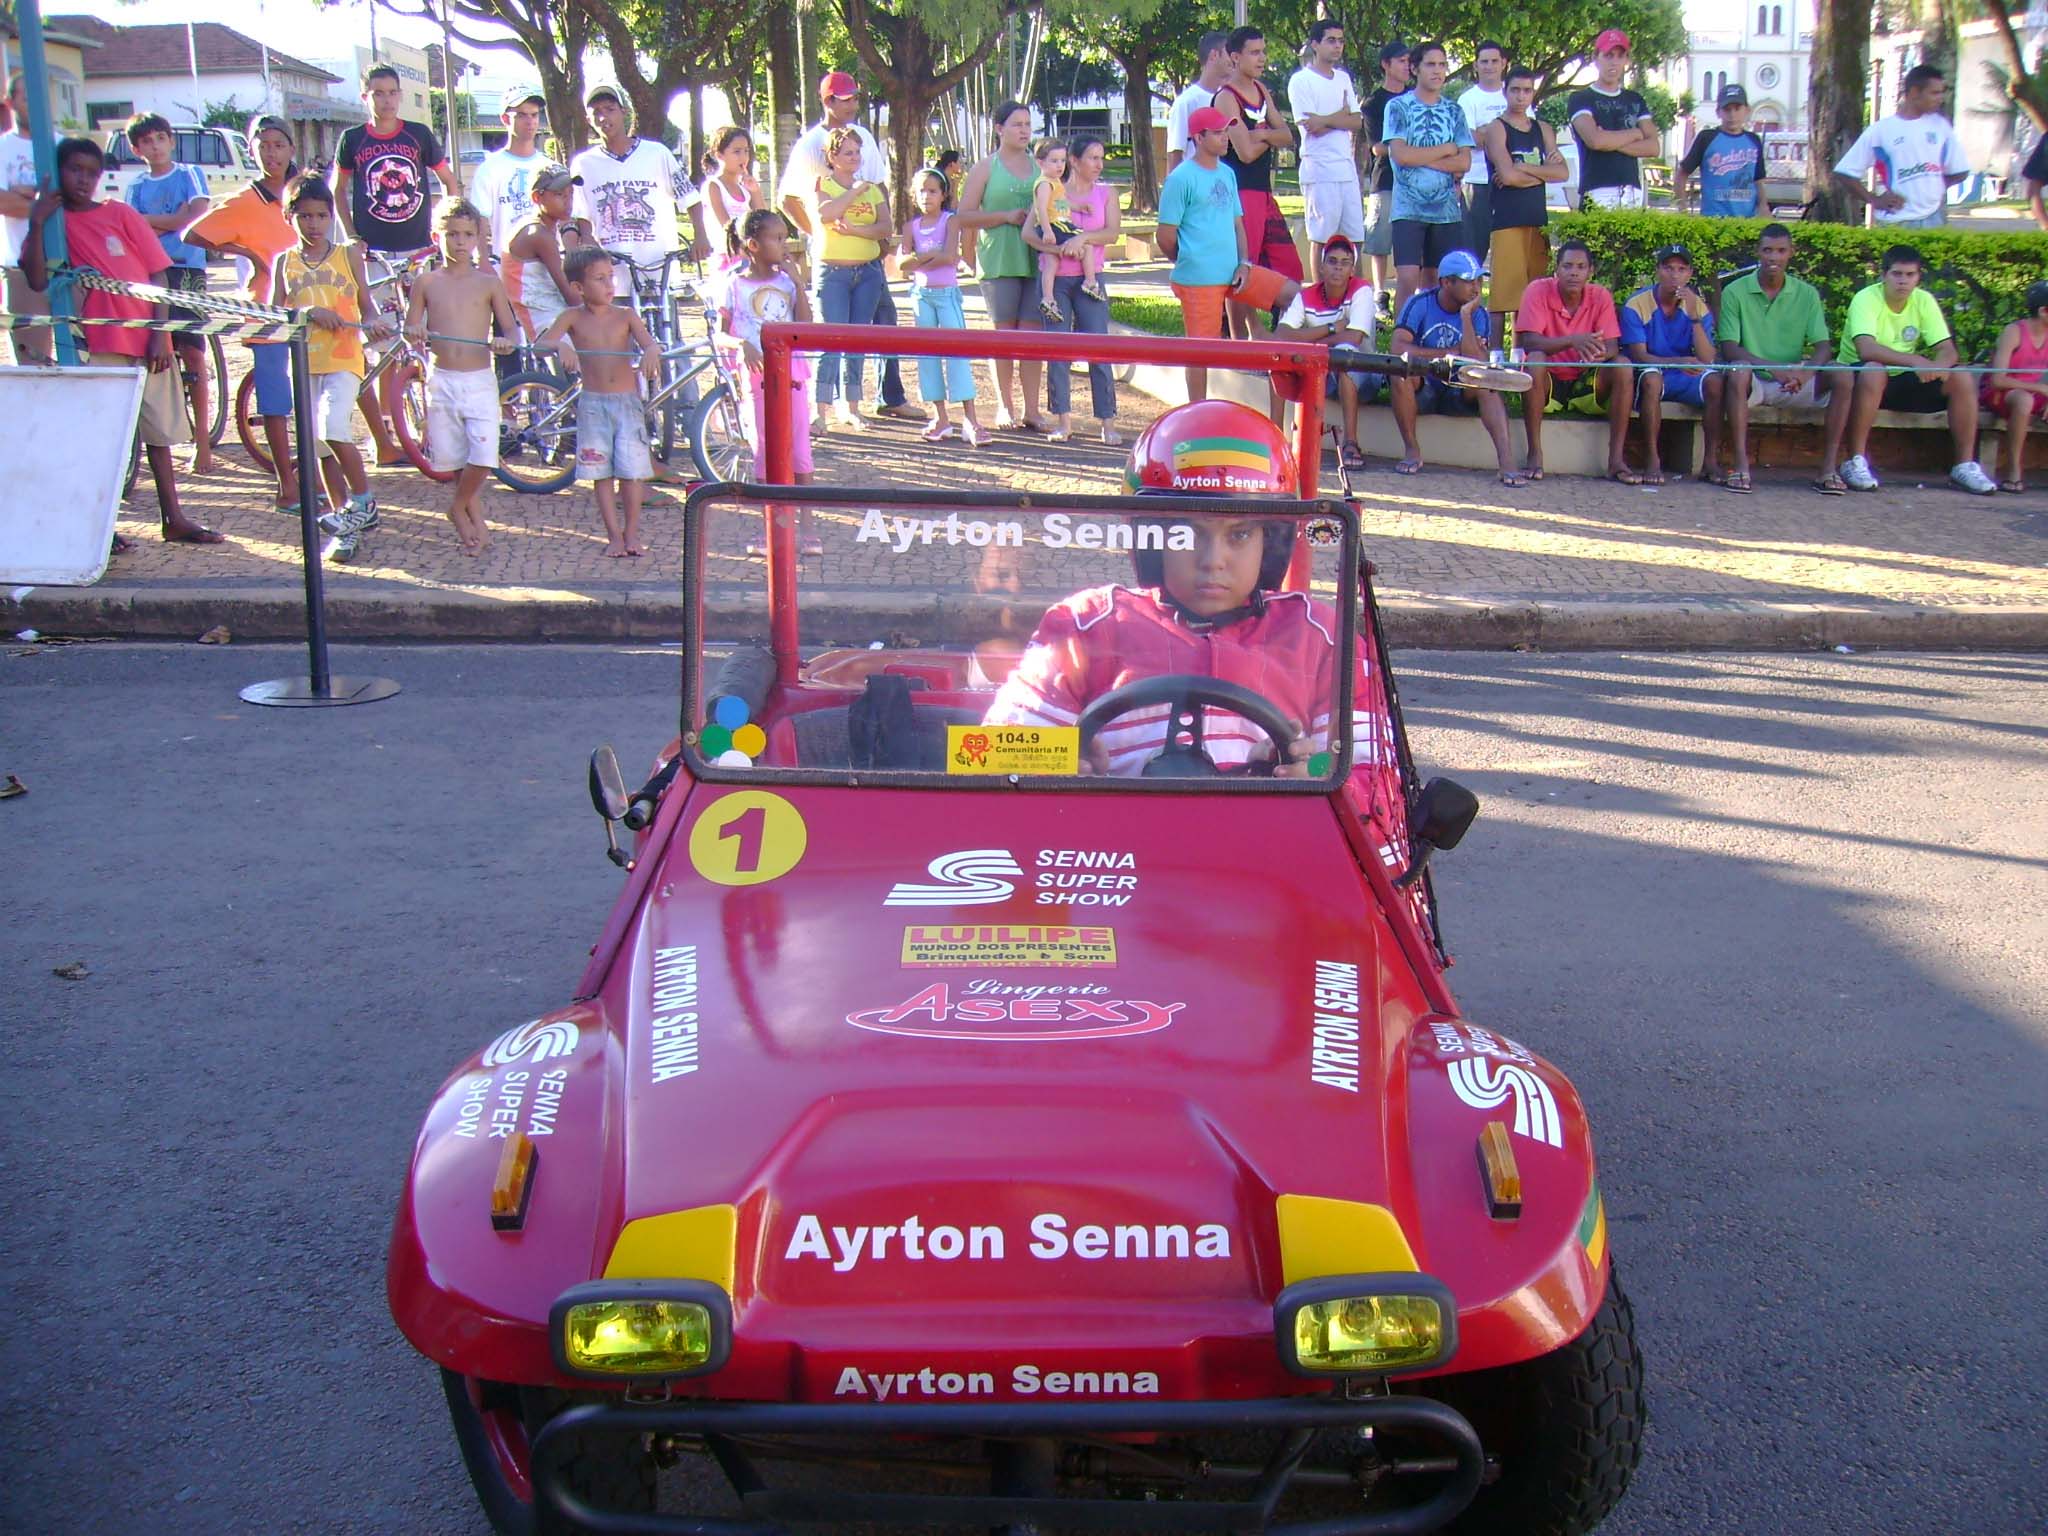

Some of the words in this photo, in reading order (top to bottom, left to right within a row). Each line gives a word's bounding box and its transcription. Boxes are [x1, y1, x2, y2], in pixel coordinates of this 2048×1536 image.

[623, 180, 658, 189] FAVELA
[1173, 475, 1220, 490] Ayrton
[1225, 475, 1267, 489] Senna
[855, 508, 1024, 553] Ayrton
[1042, 513, 1196, 551] Senna
[996, 732, 1040, 743] 104.9
[719, 807, 766, 872] 1
[1035, 849, 1136, 869] SENNA
[1035, 873, 1138, 890] SUPER
[1035, 892, 1131, 906] SHOW
[909, 927, 1110, 944] LUILIPE
[976, 943, 1010, 951] DOS
[1015, 944, 1111, 952] PRESENTES
[916, 952, 1027, 961] Brinquedos
[653, 945, 697, 1012] AYRTON
[961, 978, 1111, 999] Lingerie
[1313, 960, 1359, 1013] SENNA
[878, 982, 1186, 1023] ASEXY
[652, 1012, 698, 1084] SENNA
[1311, 1012, 1359, 1092] AYRTON
[454, 1077, 492, 1138] SHOW
[488, 1071, 530, 1138] SUPER
[527, 1069, 567, 1136] SENNA
[785, 1214, 1005, 1272] Ayrton
[1029, 1213, 1230, 1259] Senna
[835, 1366, 994, 1401] Ayrton
[1011, 1365, 1159, 1393] Senna
